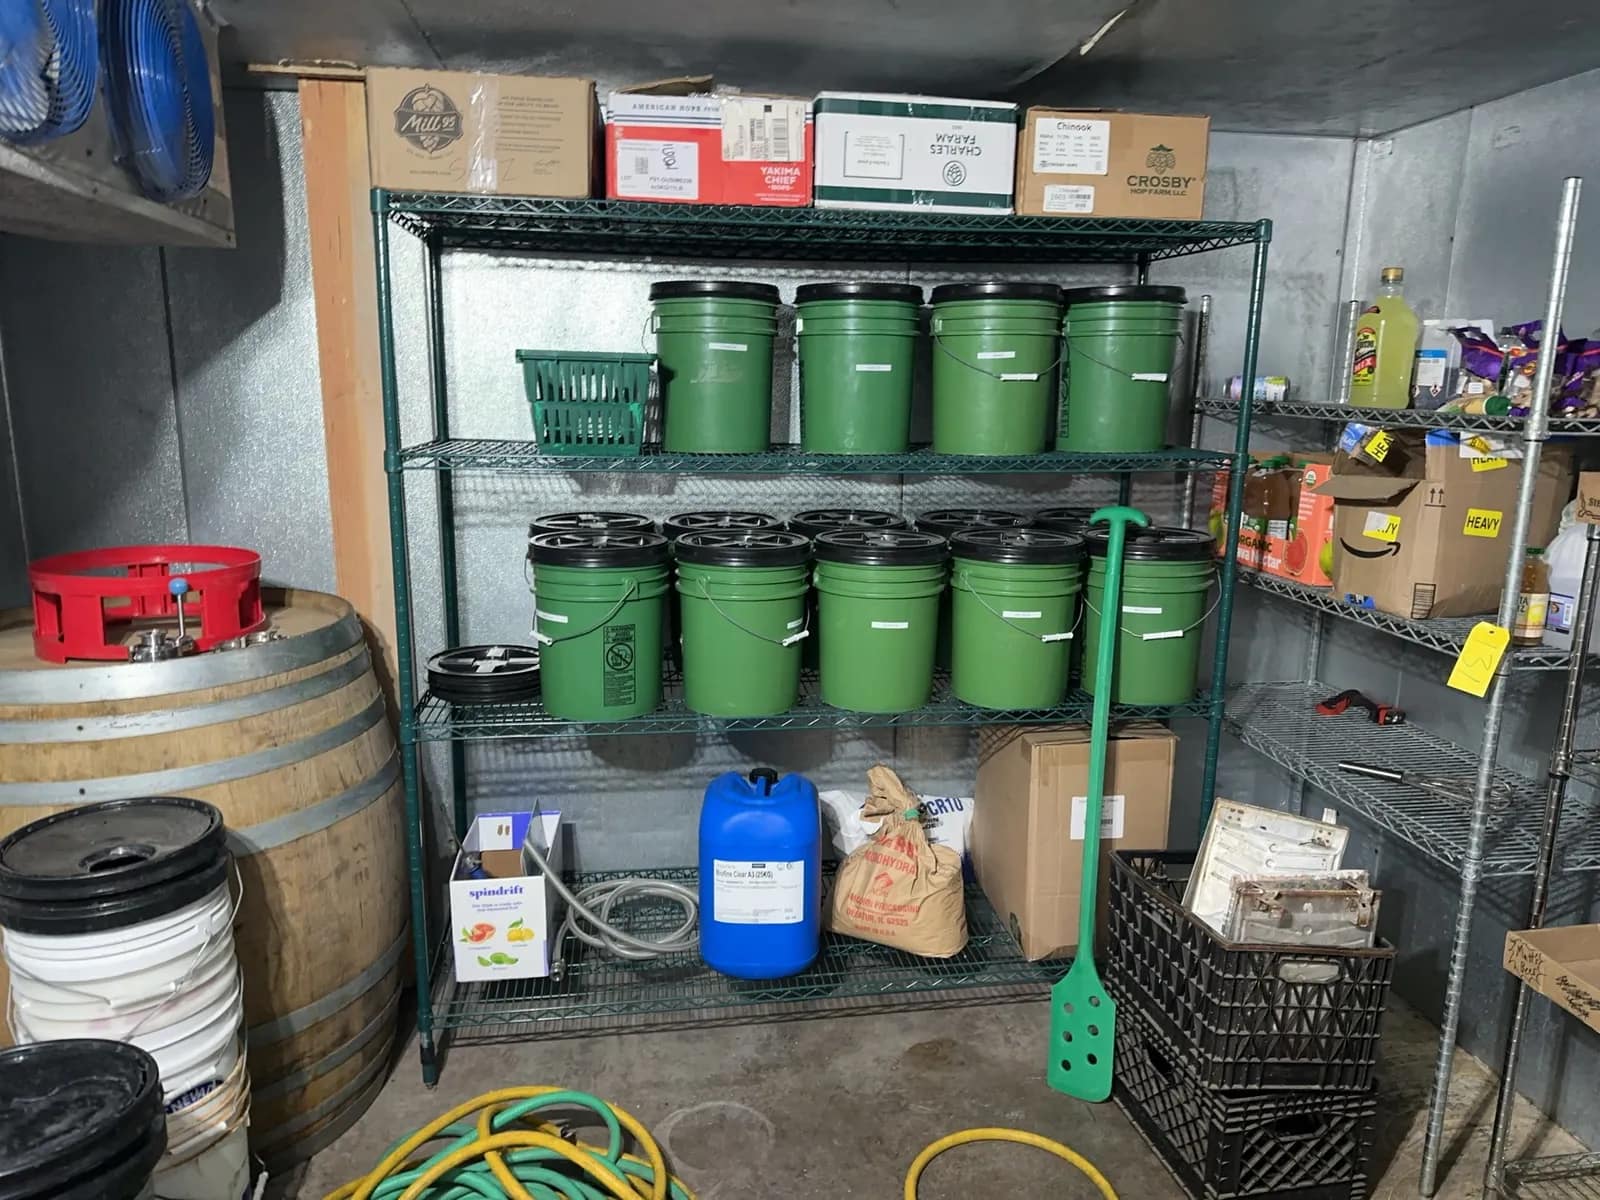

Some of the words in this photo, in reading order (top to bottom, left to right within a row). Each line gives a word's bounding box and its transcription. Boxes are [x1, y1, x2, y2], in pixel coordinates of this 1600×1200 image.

[632, 103, 676, 111] AMERICAN
[401, 114, 441, 132] Mill
[442, 115, 457, 129] 95
[1056, 121, 1093, 132] Chinook
[935, 133, 976, 145] FARAM
[930, 144, 983, 156] CHARLES
[760, 166, 800, 176] YAKIMA
[764, 175, 797, 184] CHIEF
[1127, 175, 1192, 189] CROSBY
[1466, 515, 1500, 531] HEAVY
[469, 885, 525, 900] spindrift
